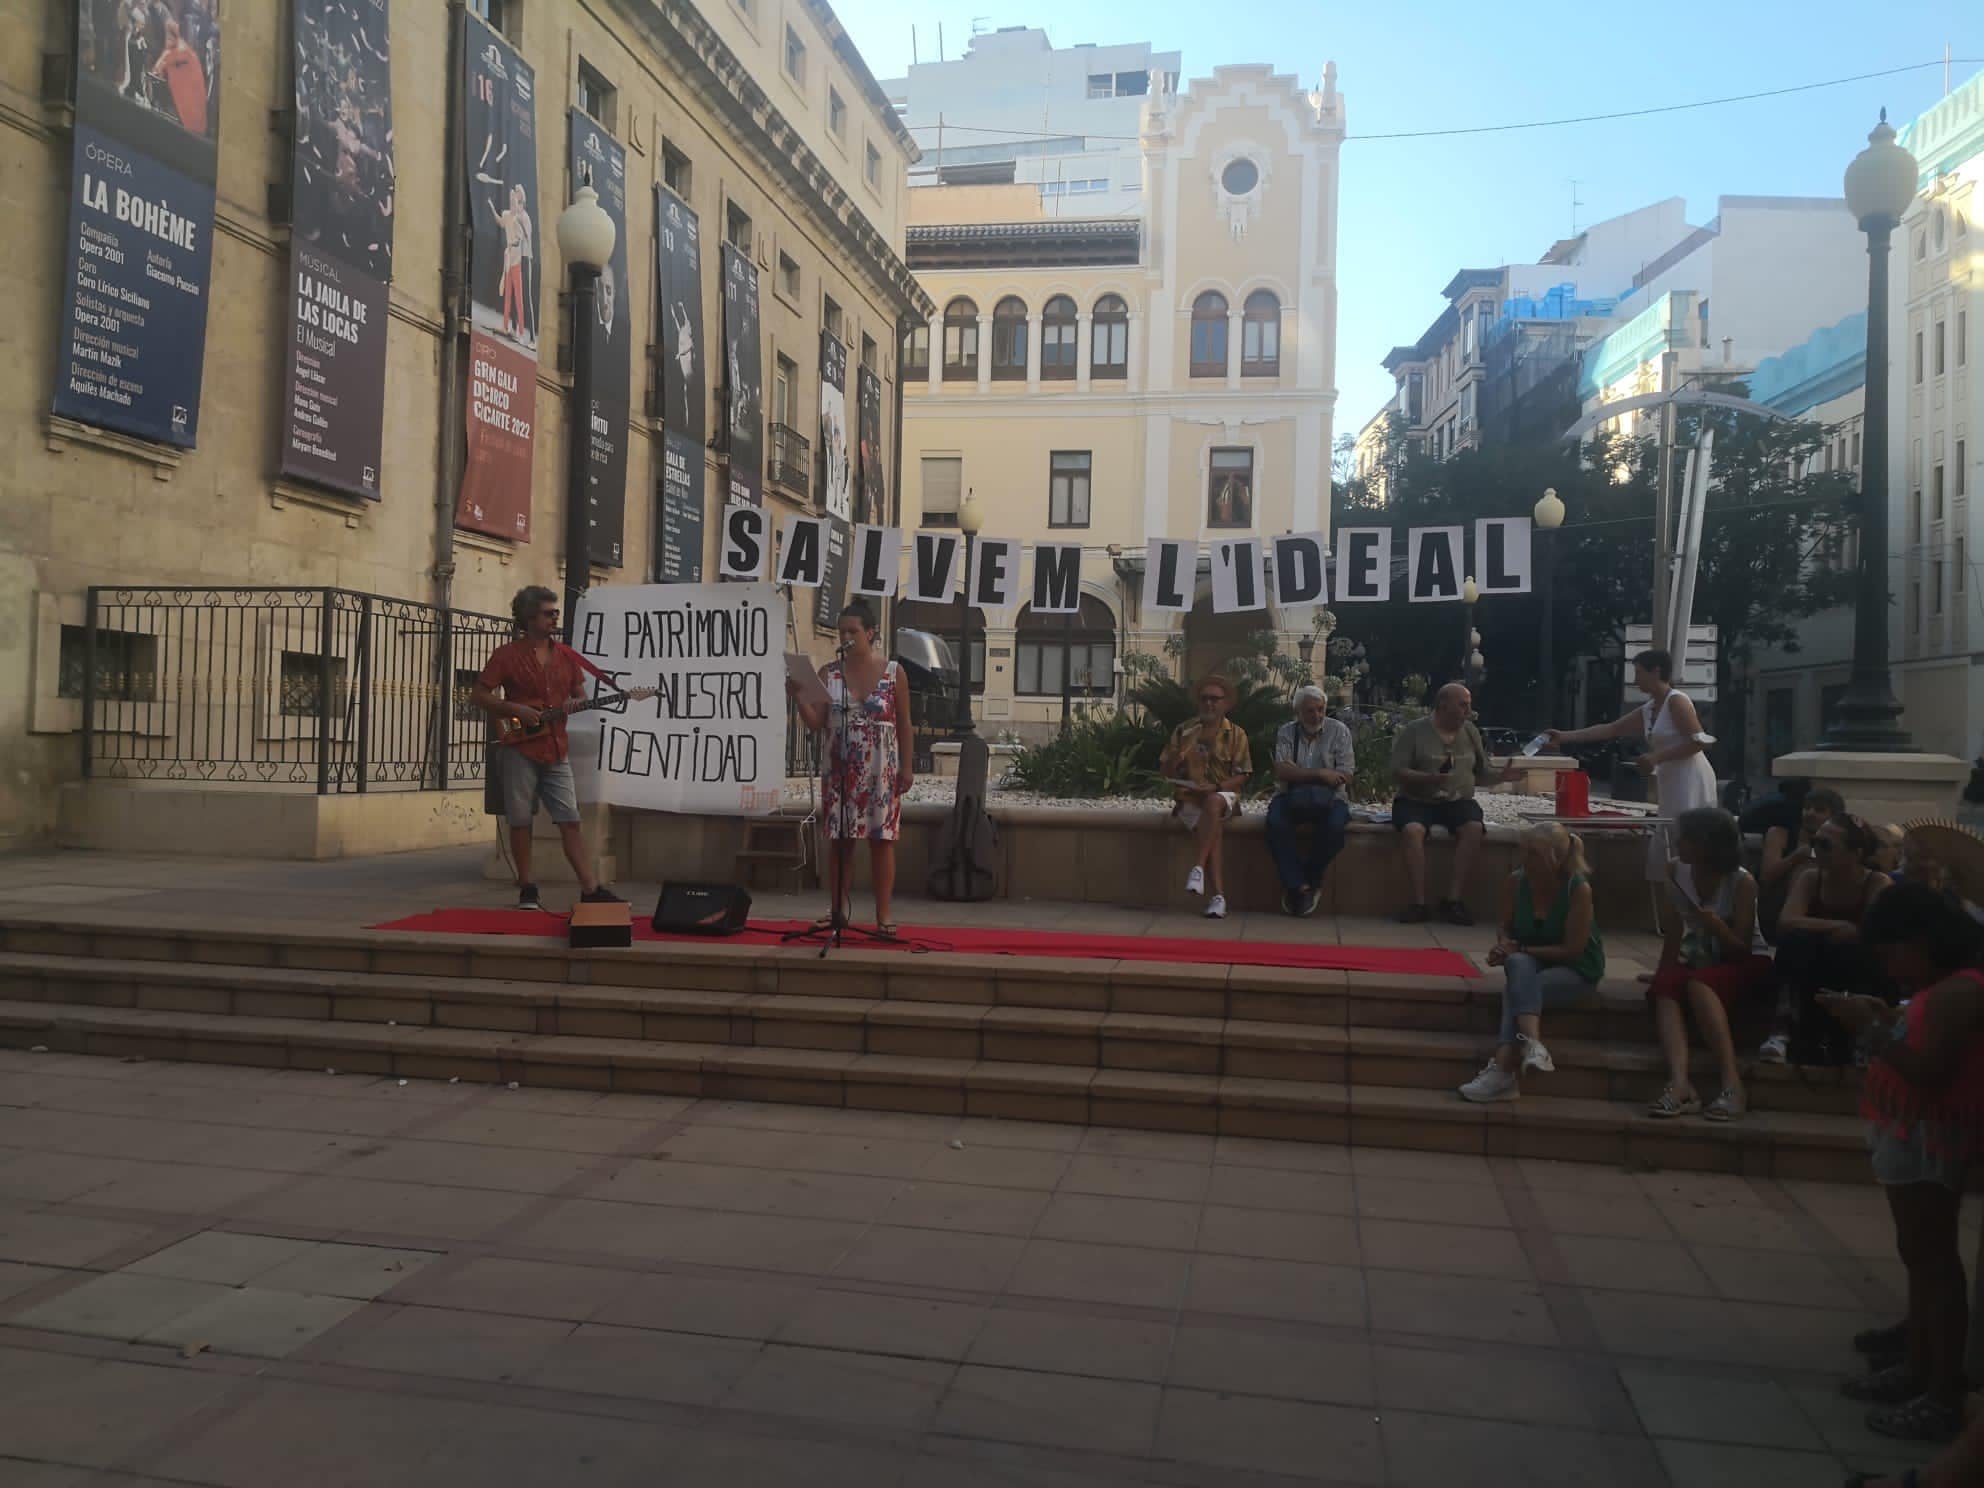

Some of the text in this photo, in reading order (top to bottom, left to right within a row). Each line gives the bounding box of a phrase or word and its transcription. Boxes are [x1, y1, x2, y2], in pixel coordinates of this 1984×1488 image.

[86, 142, 133, 176] ÓPERA
[82, 173, 197, 252] LA BOHÈME
[79, 257, 97, 274] Coro
[80, 236, 125, 265] Opera 2001
[78, 271, 96, 289] Coro
[98, 279, 119, 298] Lírico
[299, 271, 367, 325] LA JAULA DE
[75, 307, 120, 333] Opera 2001
[298, 297, 358, 344] LAS LOCAS
[296, 324, 336, 357] El Musical
[497, 369, 518, 394] GALA
[511, 416, 531, 440] 2022
[727, 509, 1081, 610] SALVEM
[1156, 523, 1521, 607] L'IDEAL
[582, 600, 769, 659] EL PATRIMONIO
[656, 671, 769, 719] NUESTRA
[597, 717, 757, 783] IDENTIDAD
